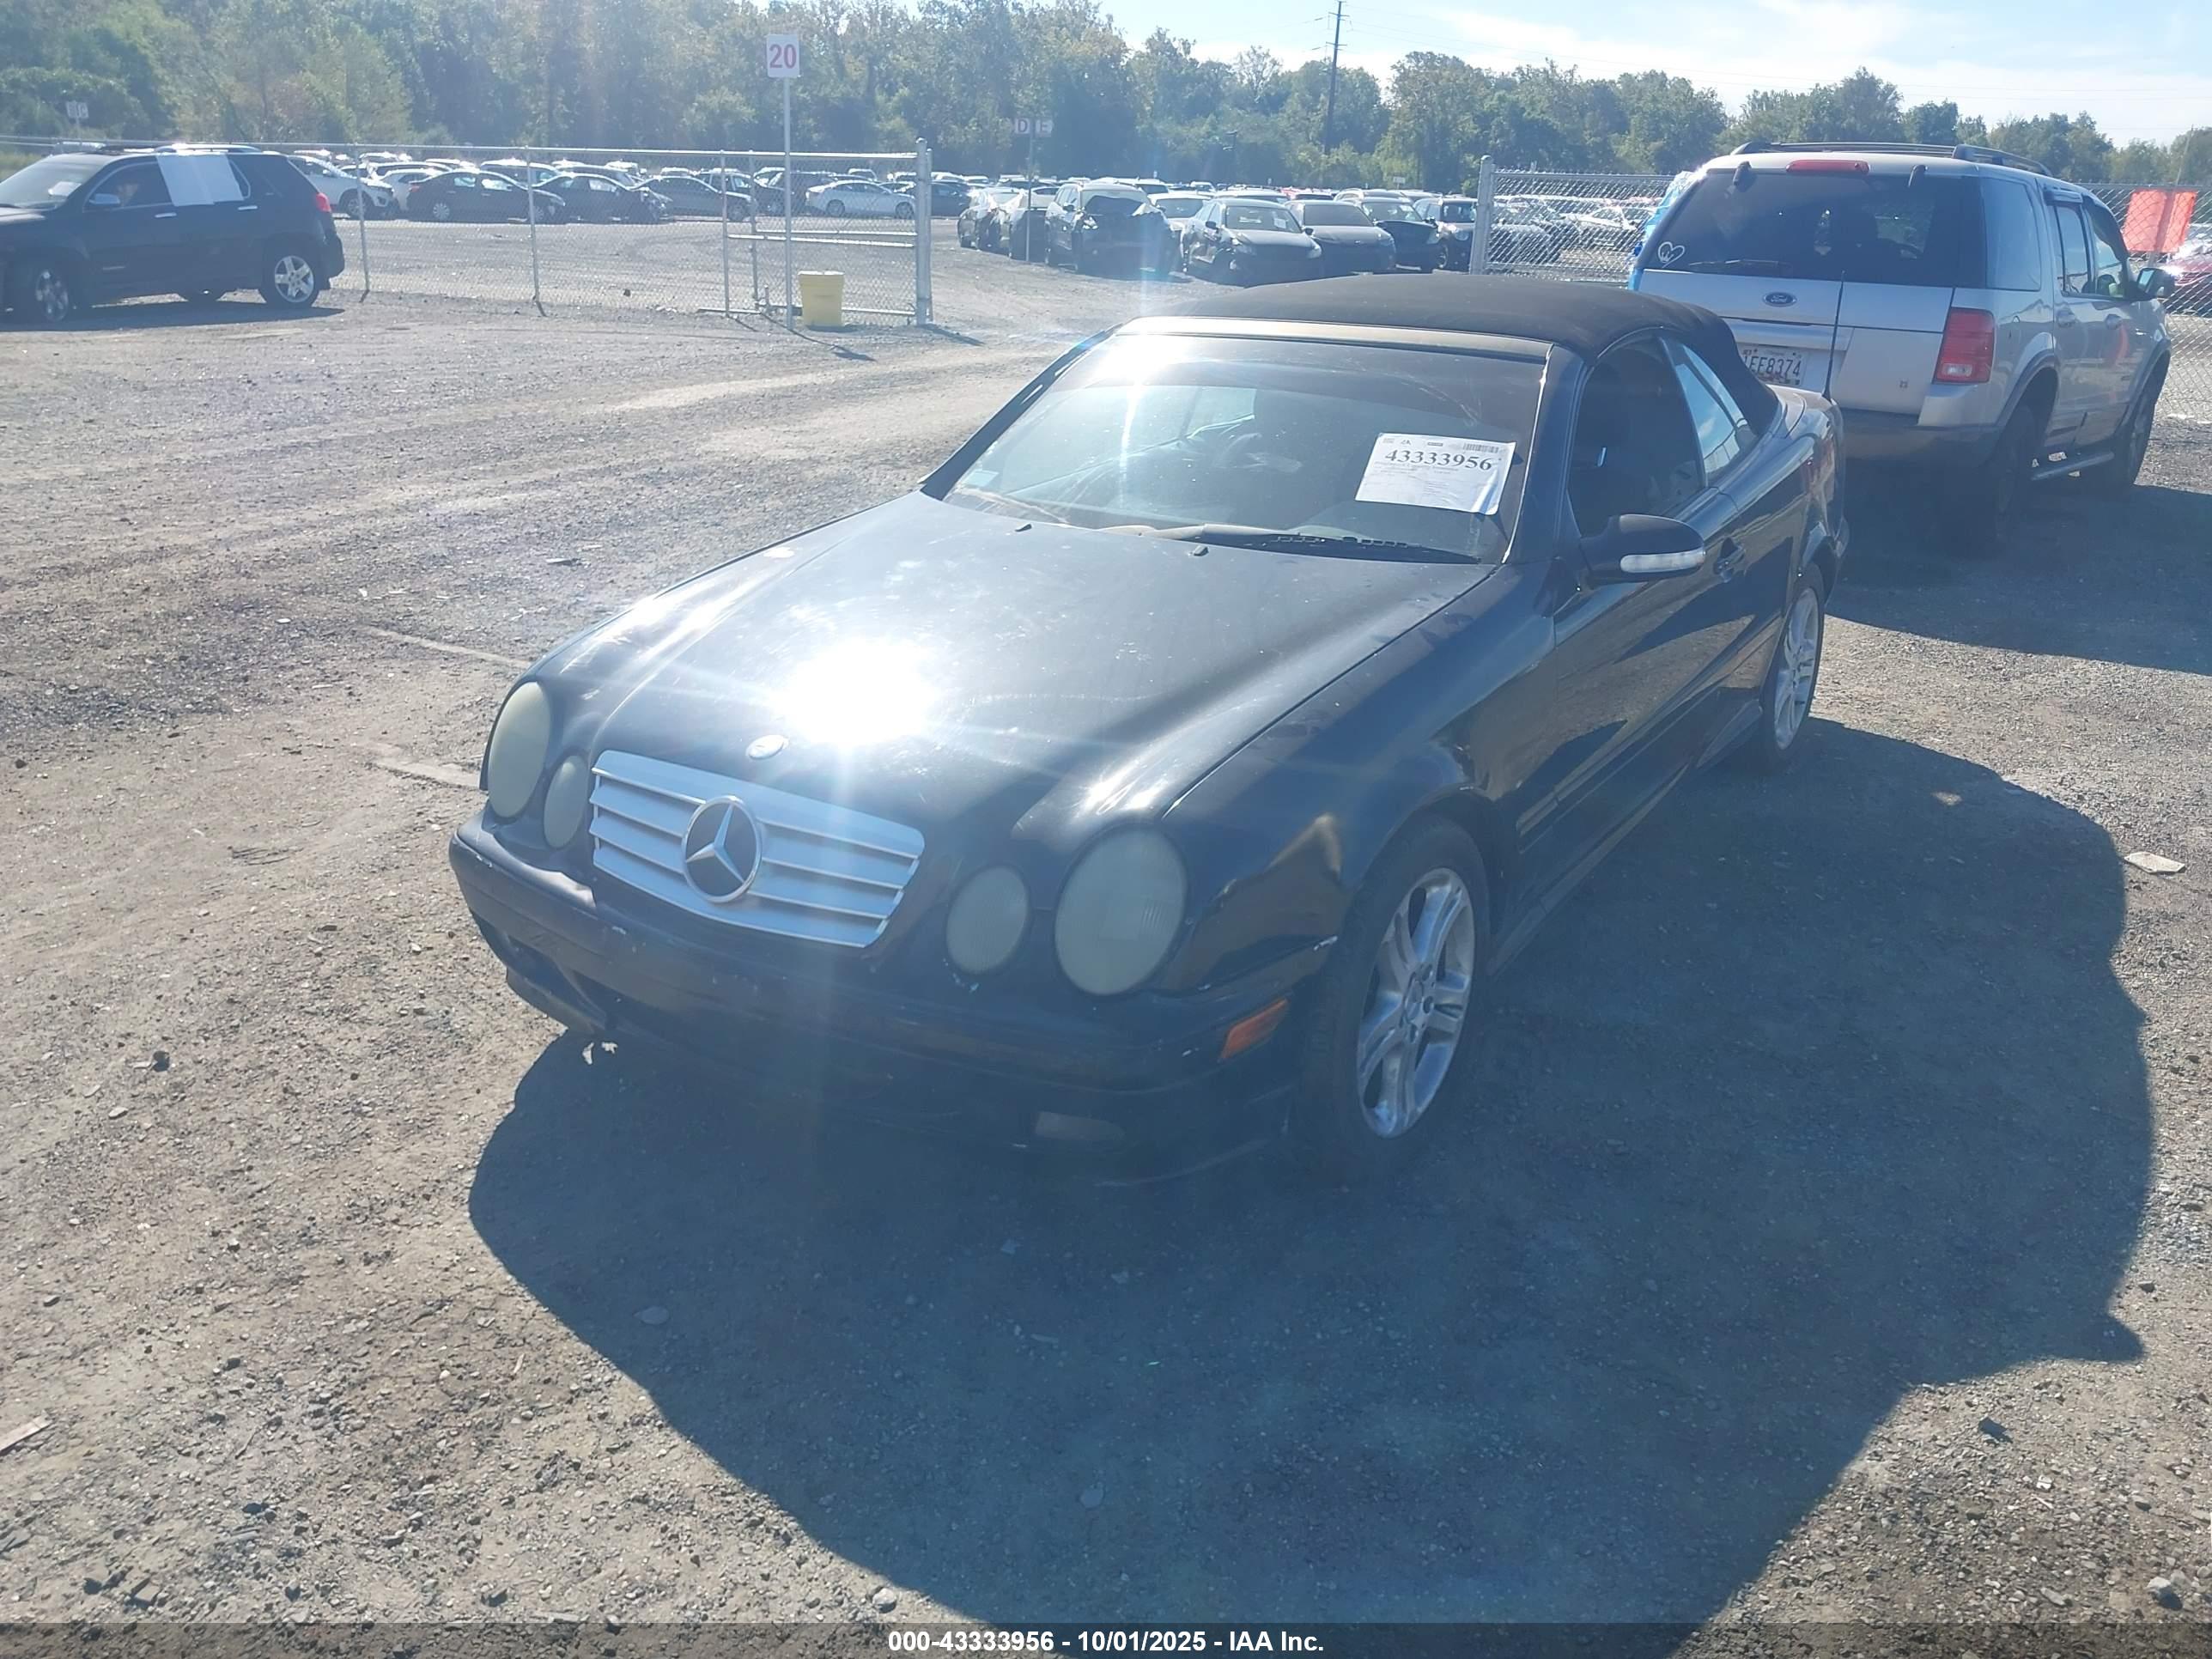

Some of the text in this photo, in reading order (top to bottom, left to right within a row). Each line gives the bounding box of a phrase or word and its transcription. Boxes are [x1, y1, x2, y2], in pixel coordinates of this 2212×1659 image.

[769, 44, 797, 69] 20
[1018, 119, 1028, 132] D
[1384, 449, 1492, 471] 43333956
